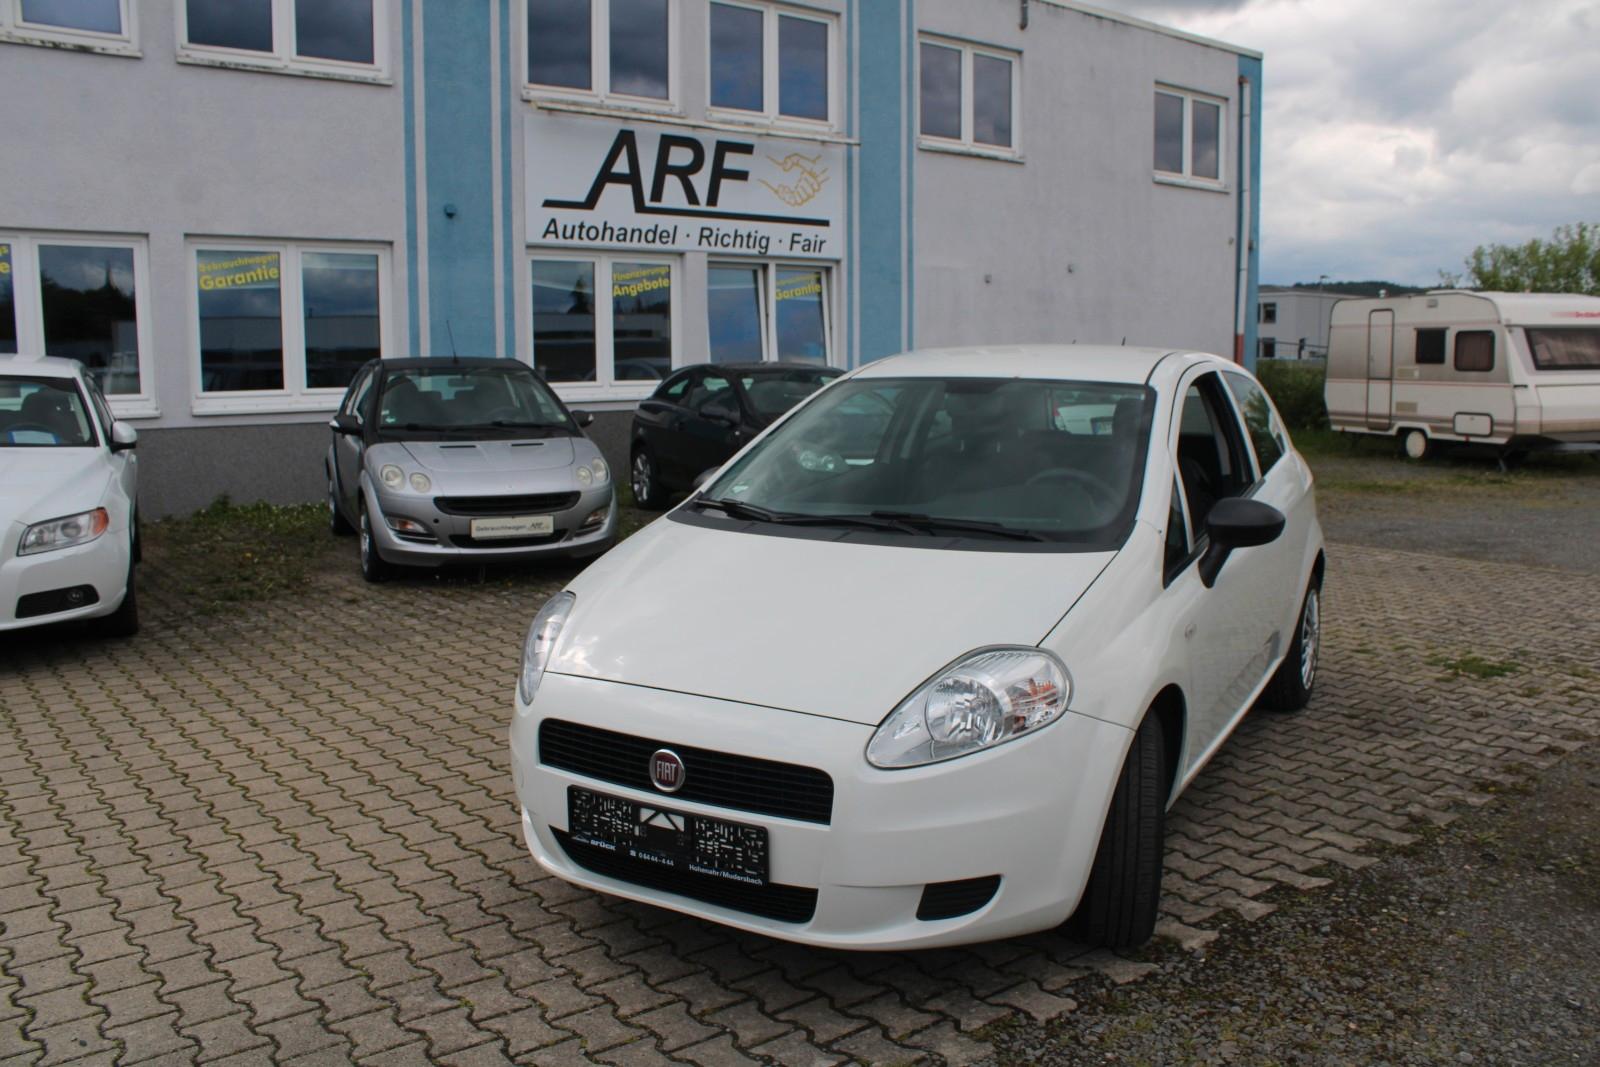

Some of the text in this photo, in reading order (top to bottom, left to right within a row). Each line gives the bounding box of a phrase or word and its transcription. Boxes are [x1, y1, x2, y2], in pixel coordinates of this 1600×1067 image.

[584, 129, 755, 214] ARF
[542, 217, 827, 255] Autohandel Richtig Fair
[200, 265, 279, 290] Garantie
[613, 277, 670, 297] Angebote
[776, 283, 821, 301] Garantie
[656, 760, 677, 782] FIAT
